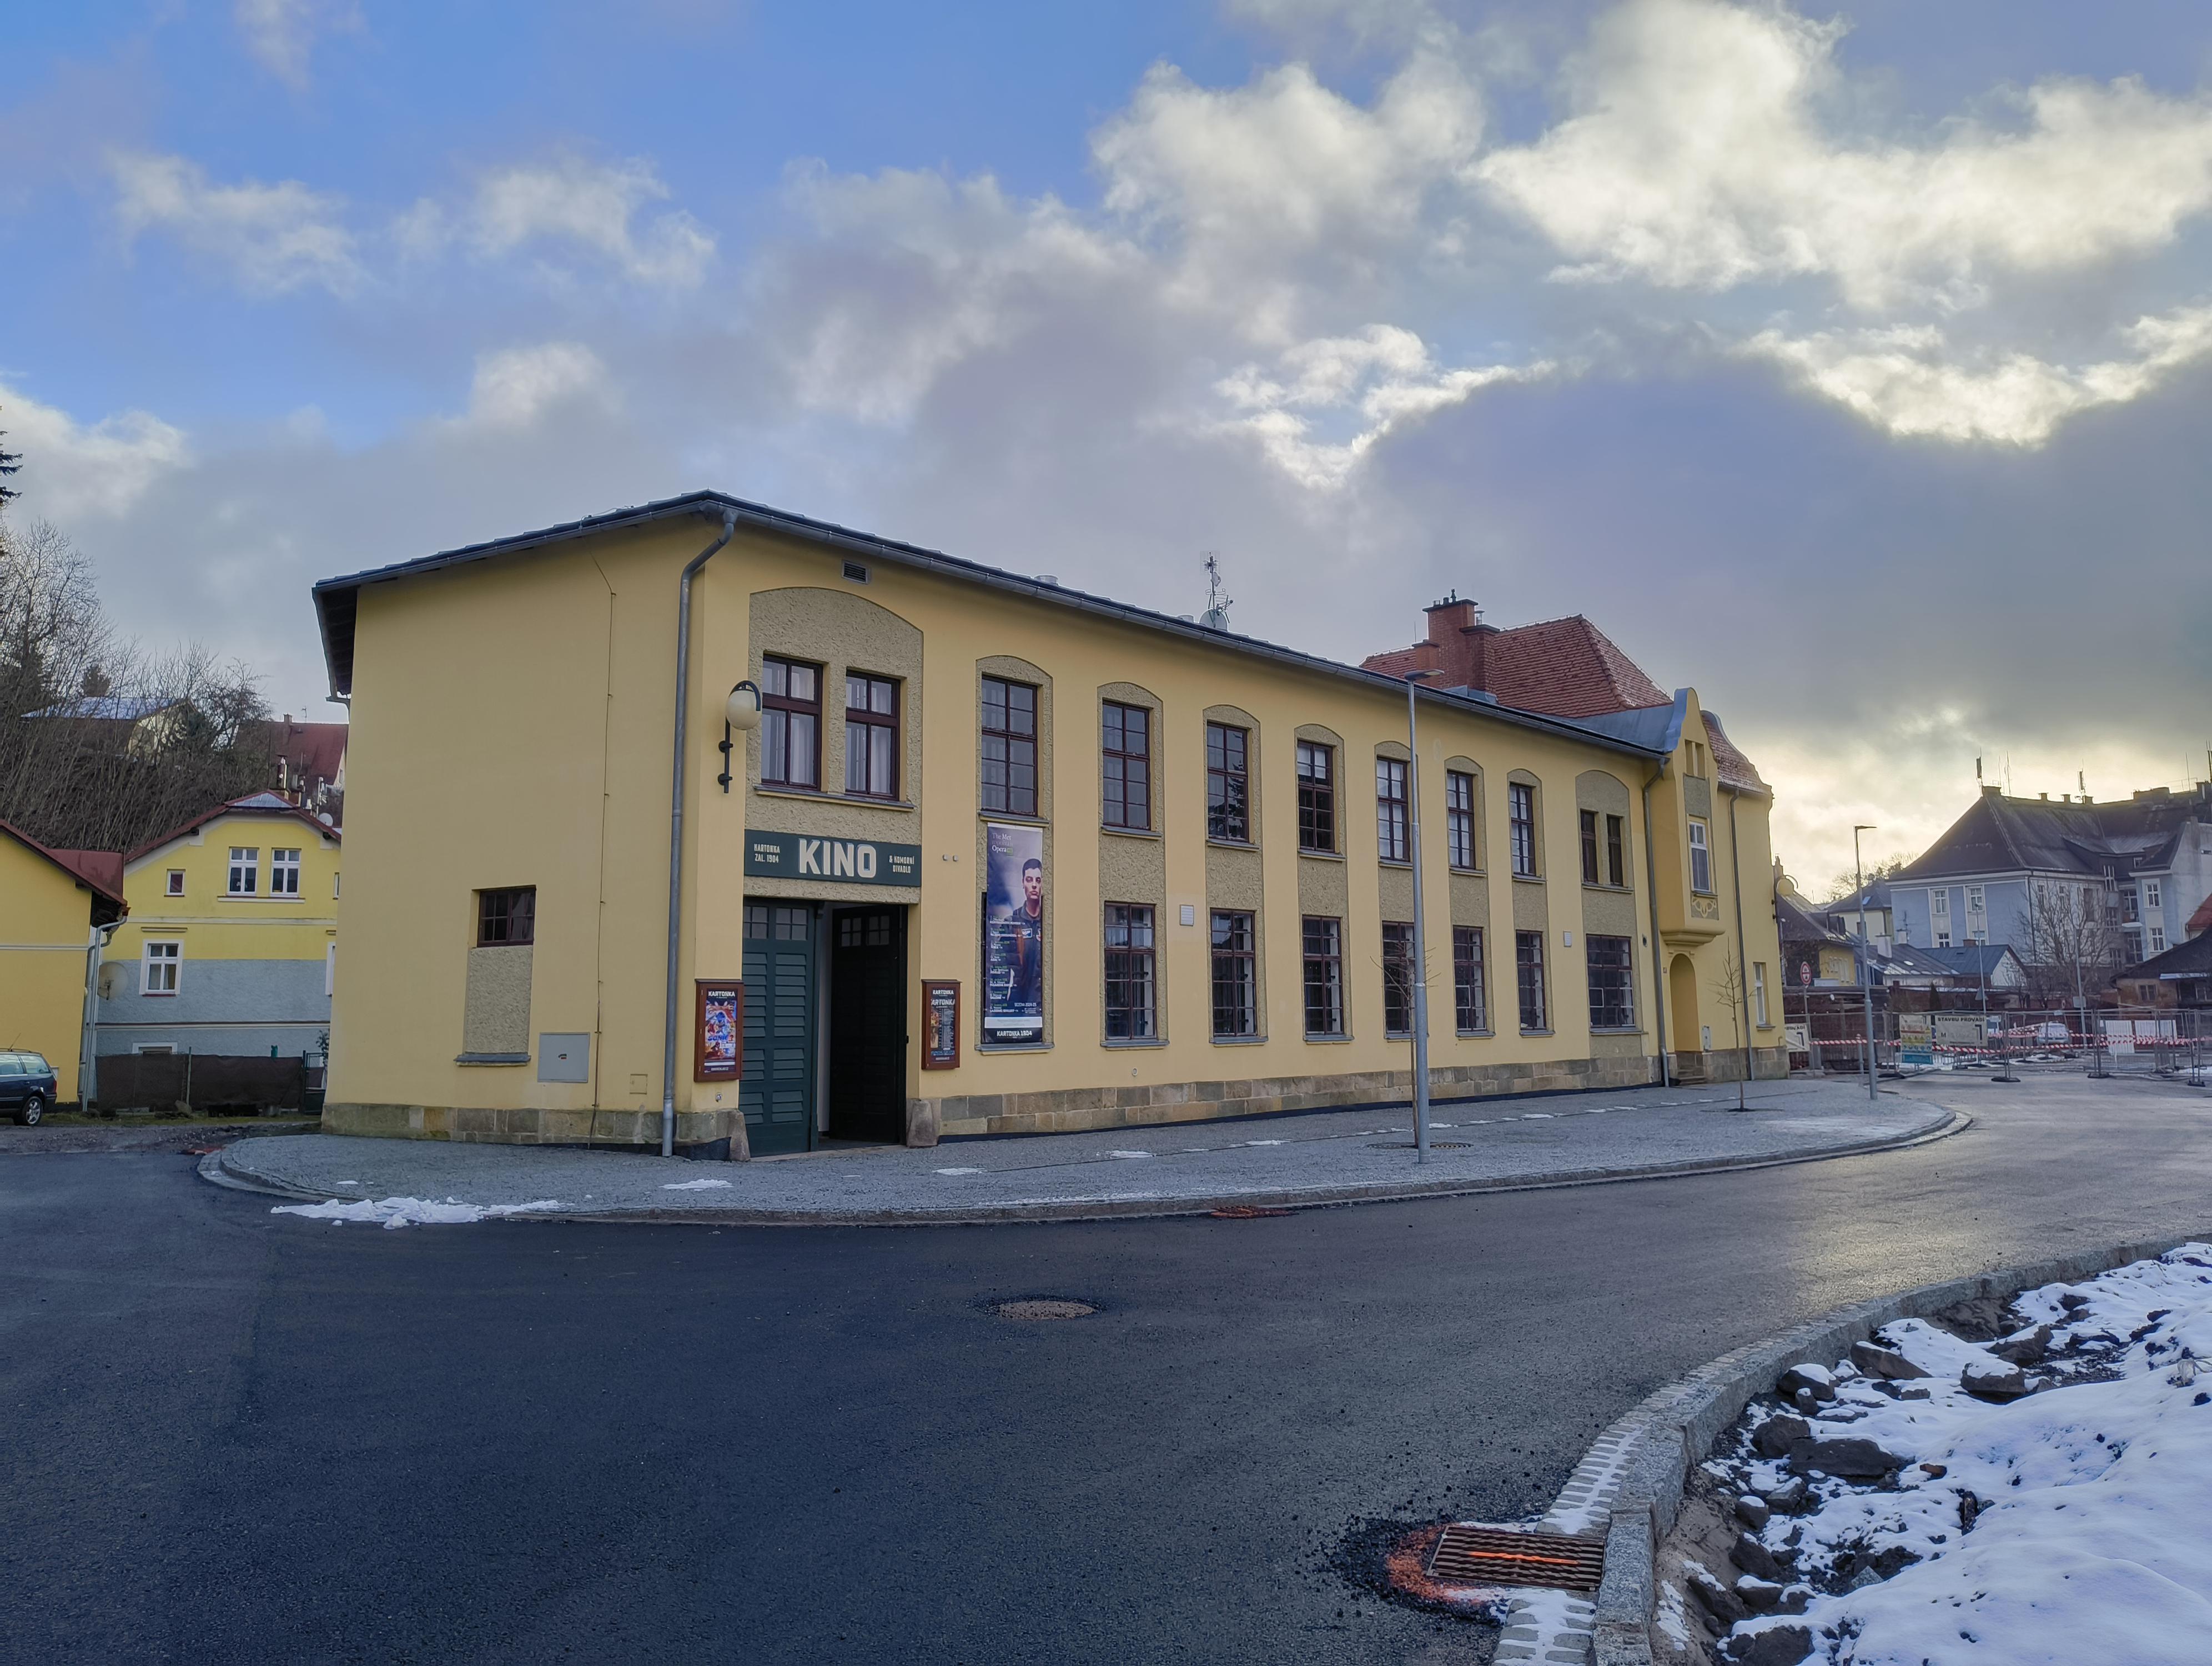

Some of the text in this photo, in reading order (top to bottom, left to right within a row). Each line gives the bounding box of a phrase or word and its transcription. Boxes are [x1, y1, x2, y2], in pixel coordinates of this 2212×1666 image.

[754, 844, 780, 853] KARTONKA
[992, 845, 1007, 853] Opera
[755, 853, 779, 863] ZAL. 1904
[798, 838, 876, 878] KINO
[894, 855, 914, 865] KOMORNÍ
[892, 865, 911, 873] DIVADLO
